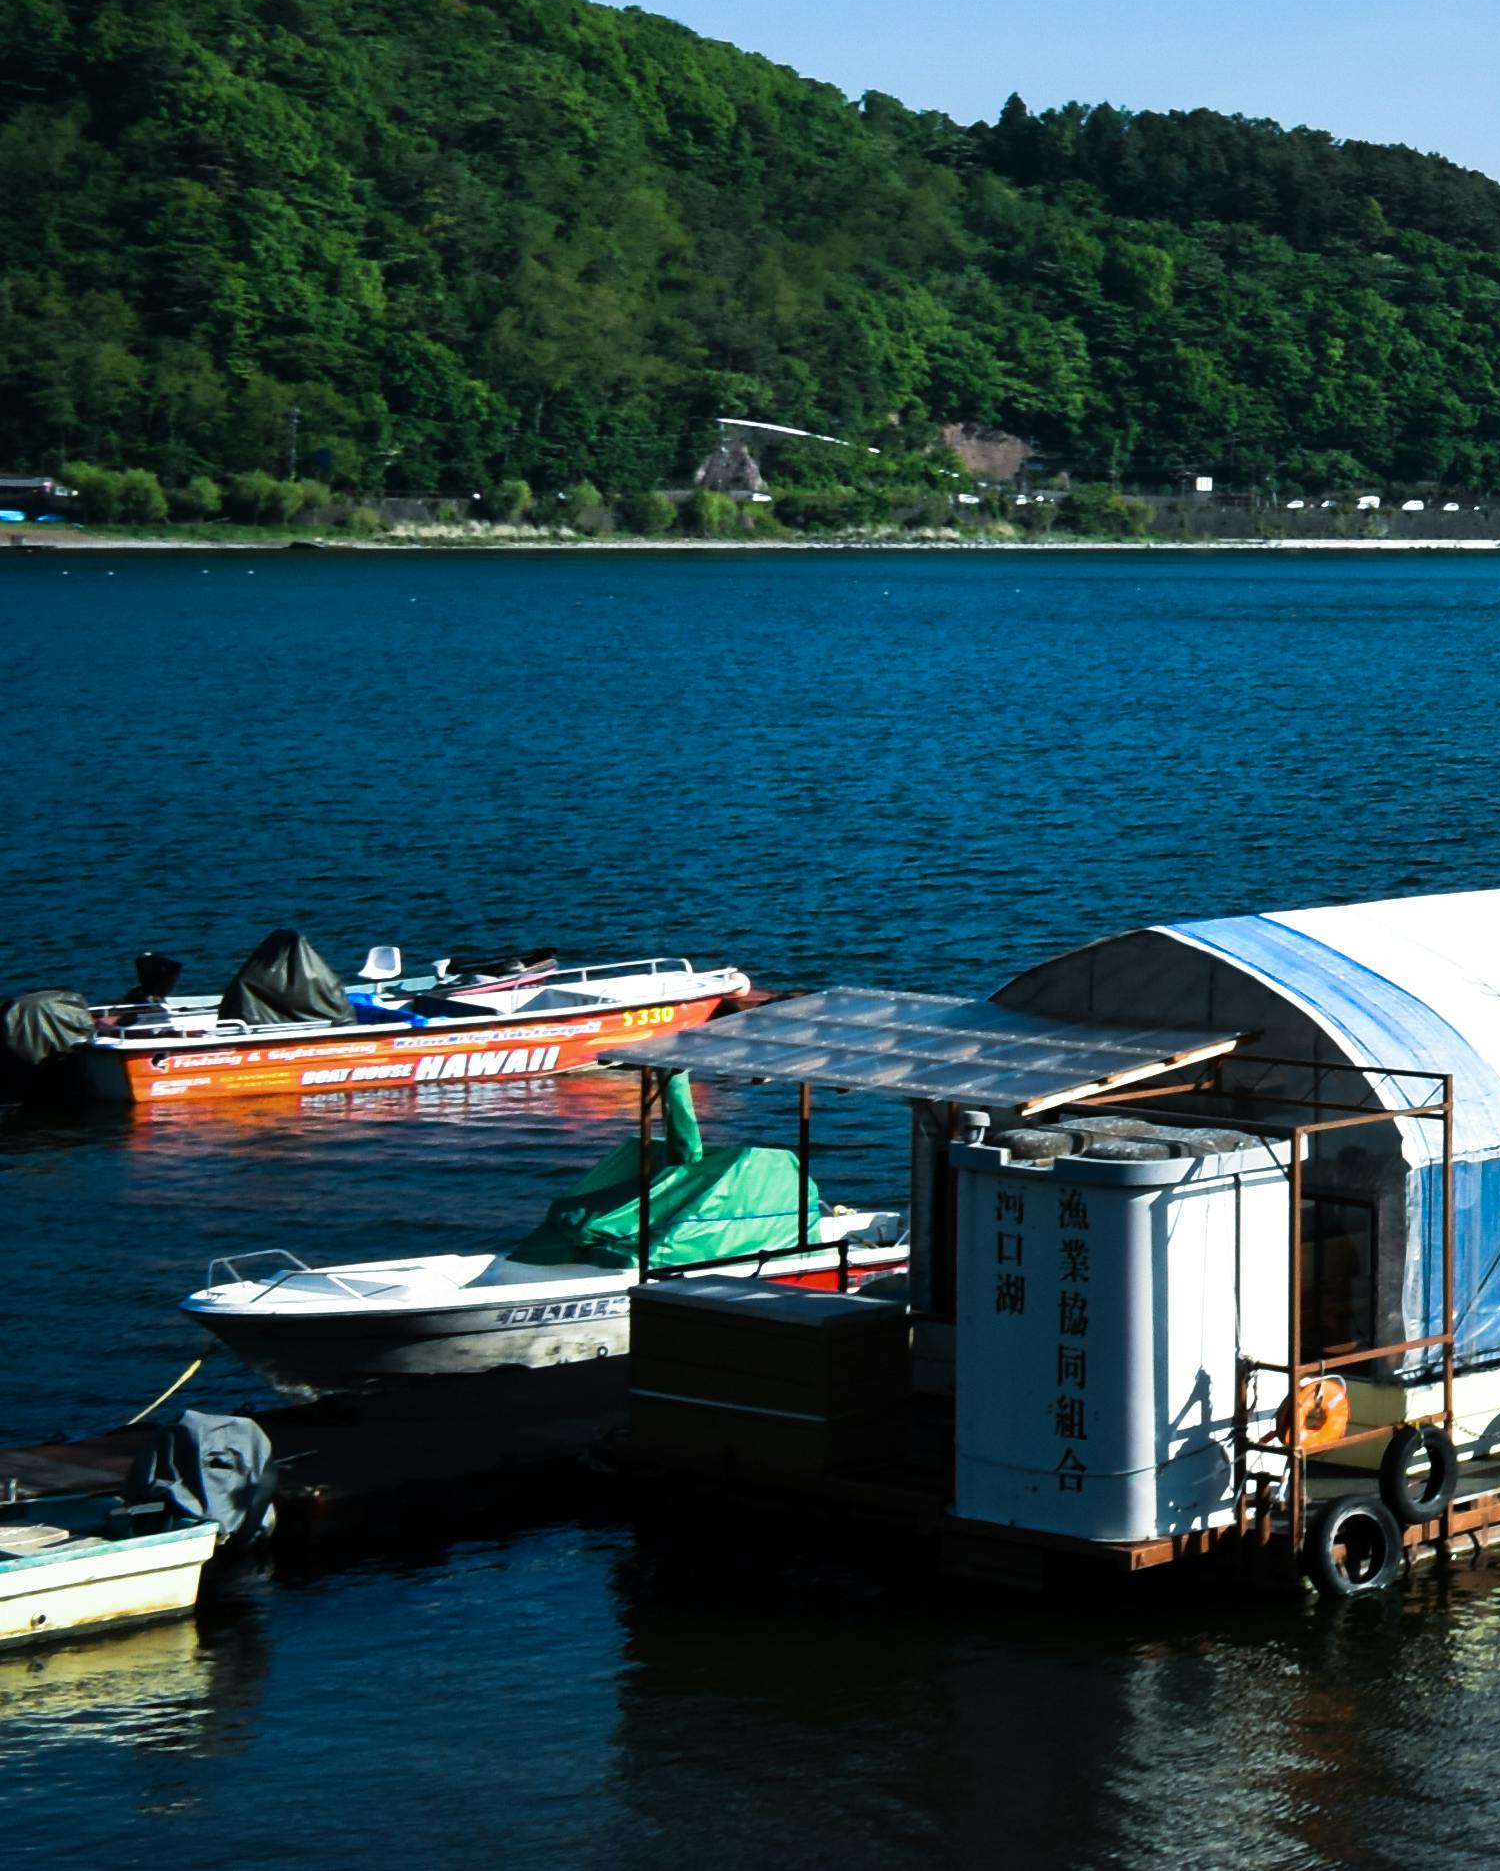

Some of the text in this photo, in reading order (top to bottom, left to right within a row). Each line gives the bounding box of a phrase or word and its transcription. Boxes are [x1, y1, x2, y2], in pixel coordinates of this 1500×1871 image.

[636, 1006, 674, 1026] 330
[173, 1043, 378, 1069] Fishing & Sightseeing
[300, 1046, 561, 1085] BOAT HOUSE HAWAII
[995, 1189, 1025, 1316] 河口湖
[1055, 1187, 1090, 1494] 漁業協同組合
